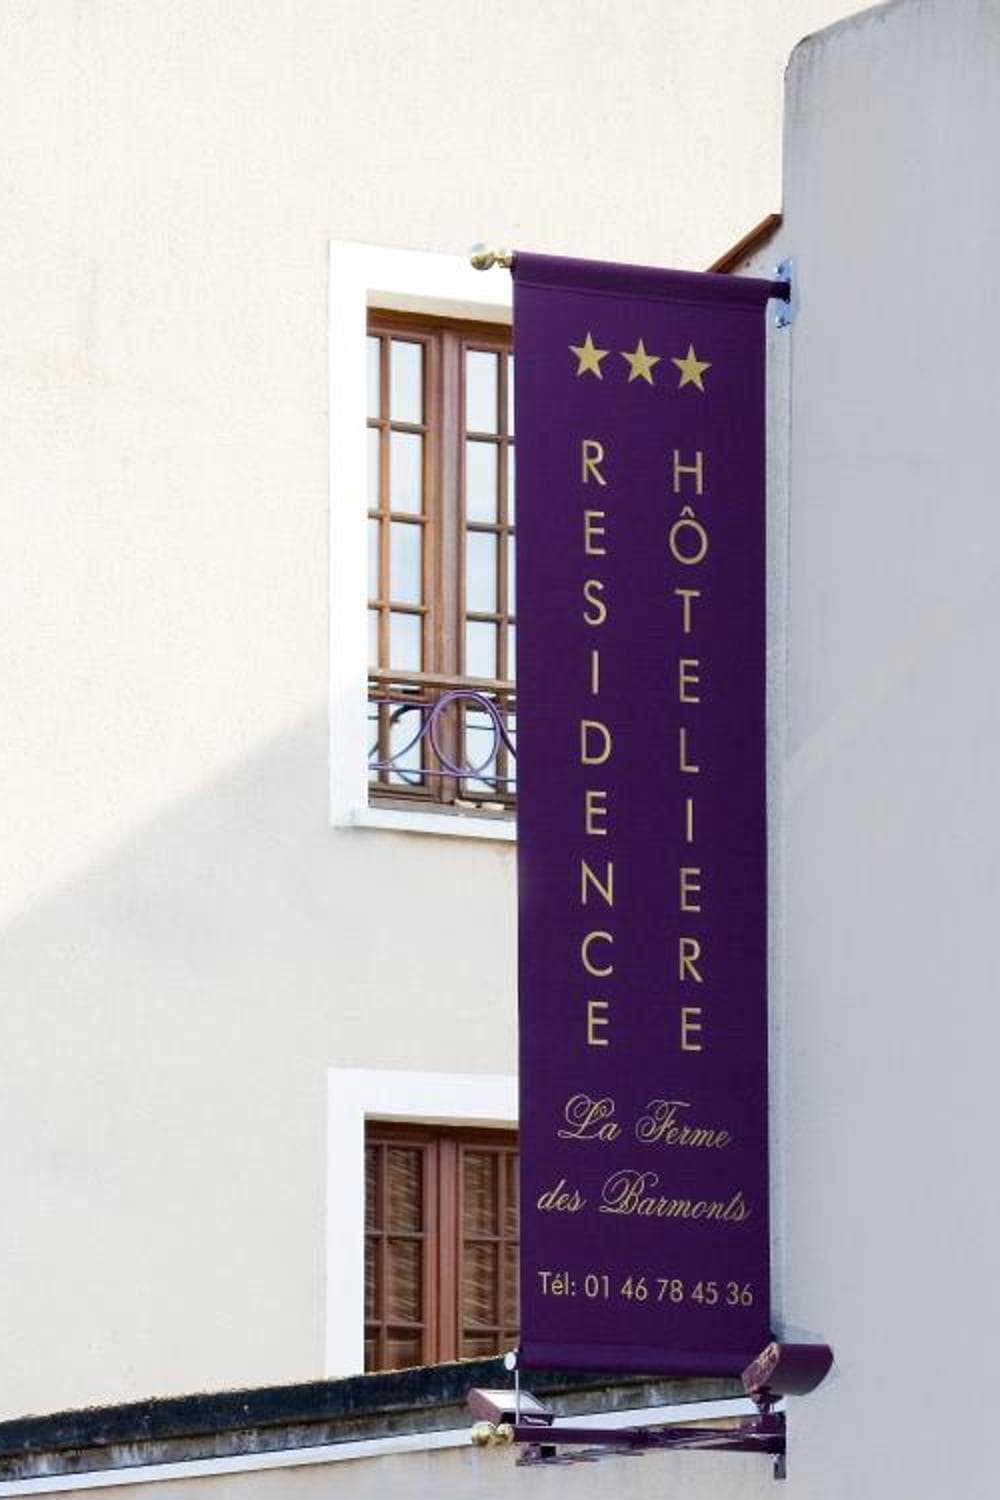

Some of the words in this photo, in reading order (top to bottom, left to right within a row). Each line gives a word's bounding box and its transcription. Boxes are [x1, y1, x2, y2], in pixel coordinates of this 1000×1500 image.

[580, 439, 614, 1045] RESIDENCE
[669, 449, 708, 1050] HÔTELIERE
[557, 1094, 621, 1141] La
[635, 1099, 731, 1149] Ferme
[537, 1179, 586, 1211] des
[600, 1169, 749, 1222] Barmonts
[538, 1271, 576, 1297] Tél:
[585, 1275, 611, 1299] 01
[621, 1276, 648, 1301] 46
[657, 1279, 683, 1302] 78
[691, 1281, 718, 1304] 45
[727, 1283, 753, 1306] 36
